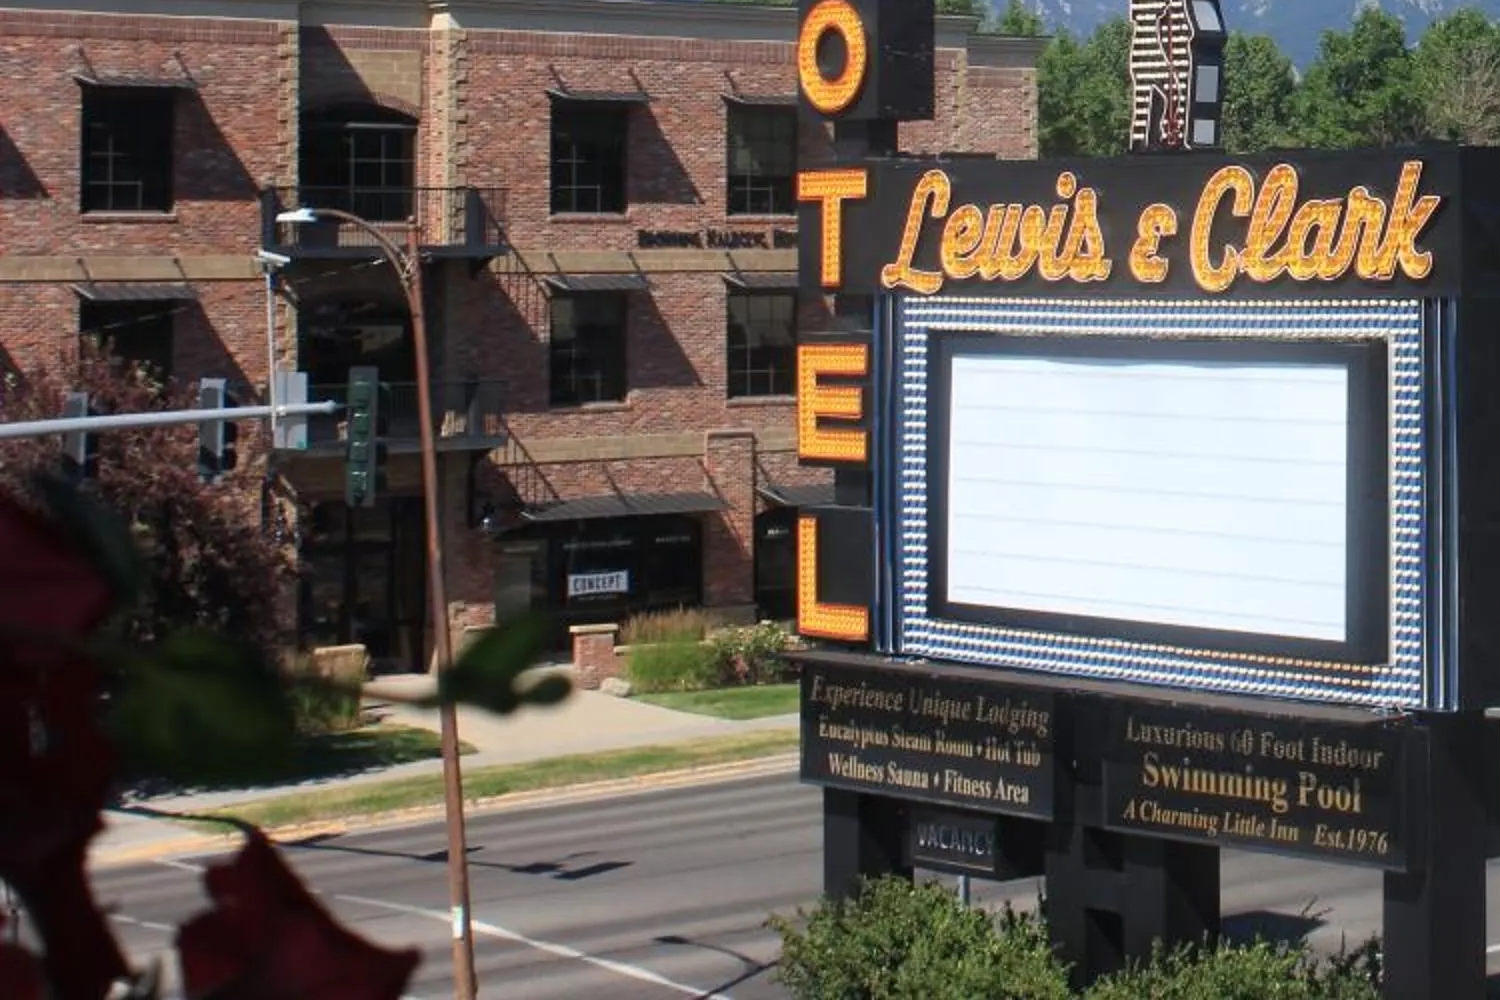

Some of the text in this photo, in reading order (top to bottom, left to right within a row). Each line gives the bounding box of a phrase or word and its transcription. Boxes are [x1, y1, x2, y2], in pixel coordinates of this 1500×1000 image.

[881, 160, 1441, 295] Lewis & Clark
[573, 573, 623, 593] CONCEPT
[811, 675, 1051, 737] Experience Unique Lodging
[819, 716, 1041, 767] Eucalyptus Steam Room Hot Tub
[1125, 716, 1384, 771] Luxurious 60 Foot Indoor
[828, 752, 1030, 805] Wellness Sauna Fitness Area
[1142, 751, 1362, 814] Swimming Pool
[916, 823, 994, 856] VACANCY
[1123, 798, 1138, 820] A
[1139, 799, 1218, 838] Charming
[1223, 811, 1266, 837] Little
[1269, 818, 1299, 842] Inn
